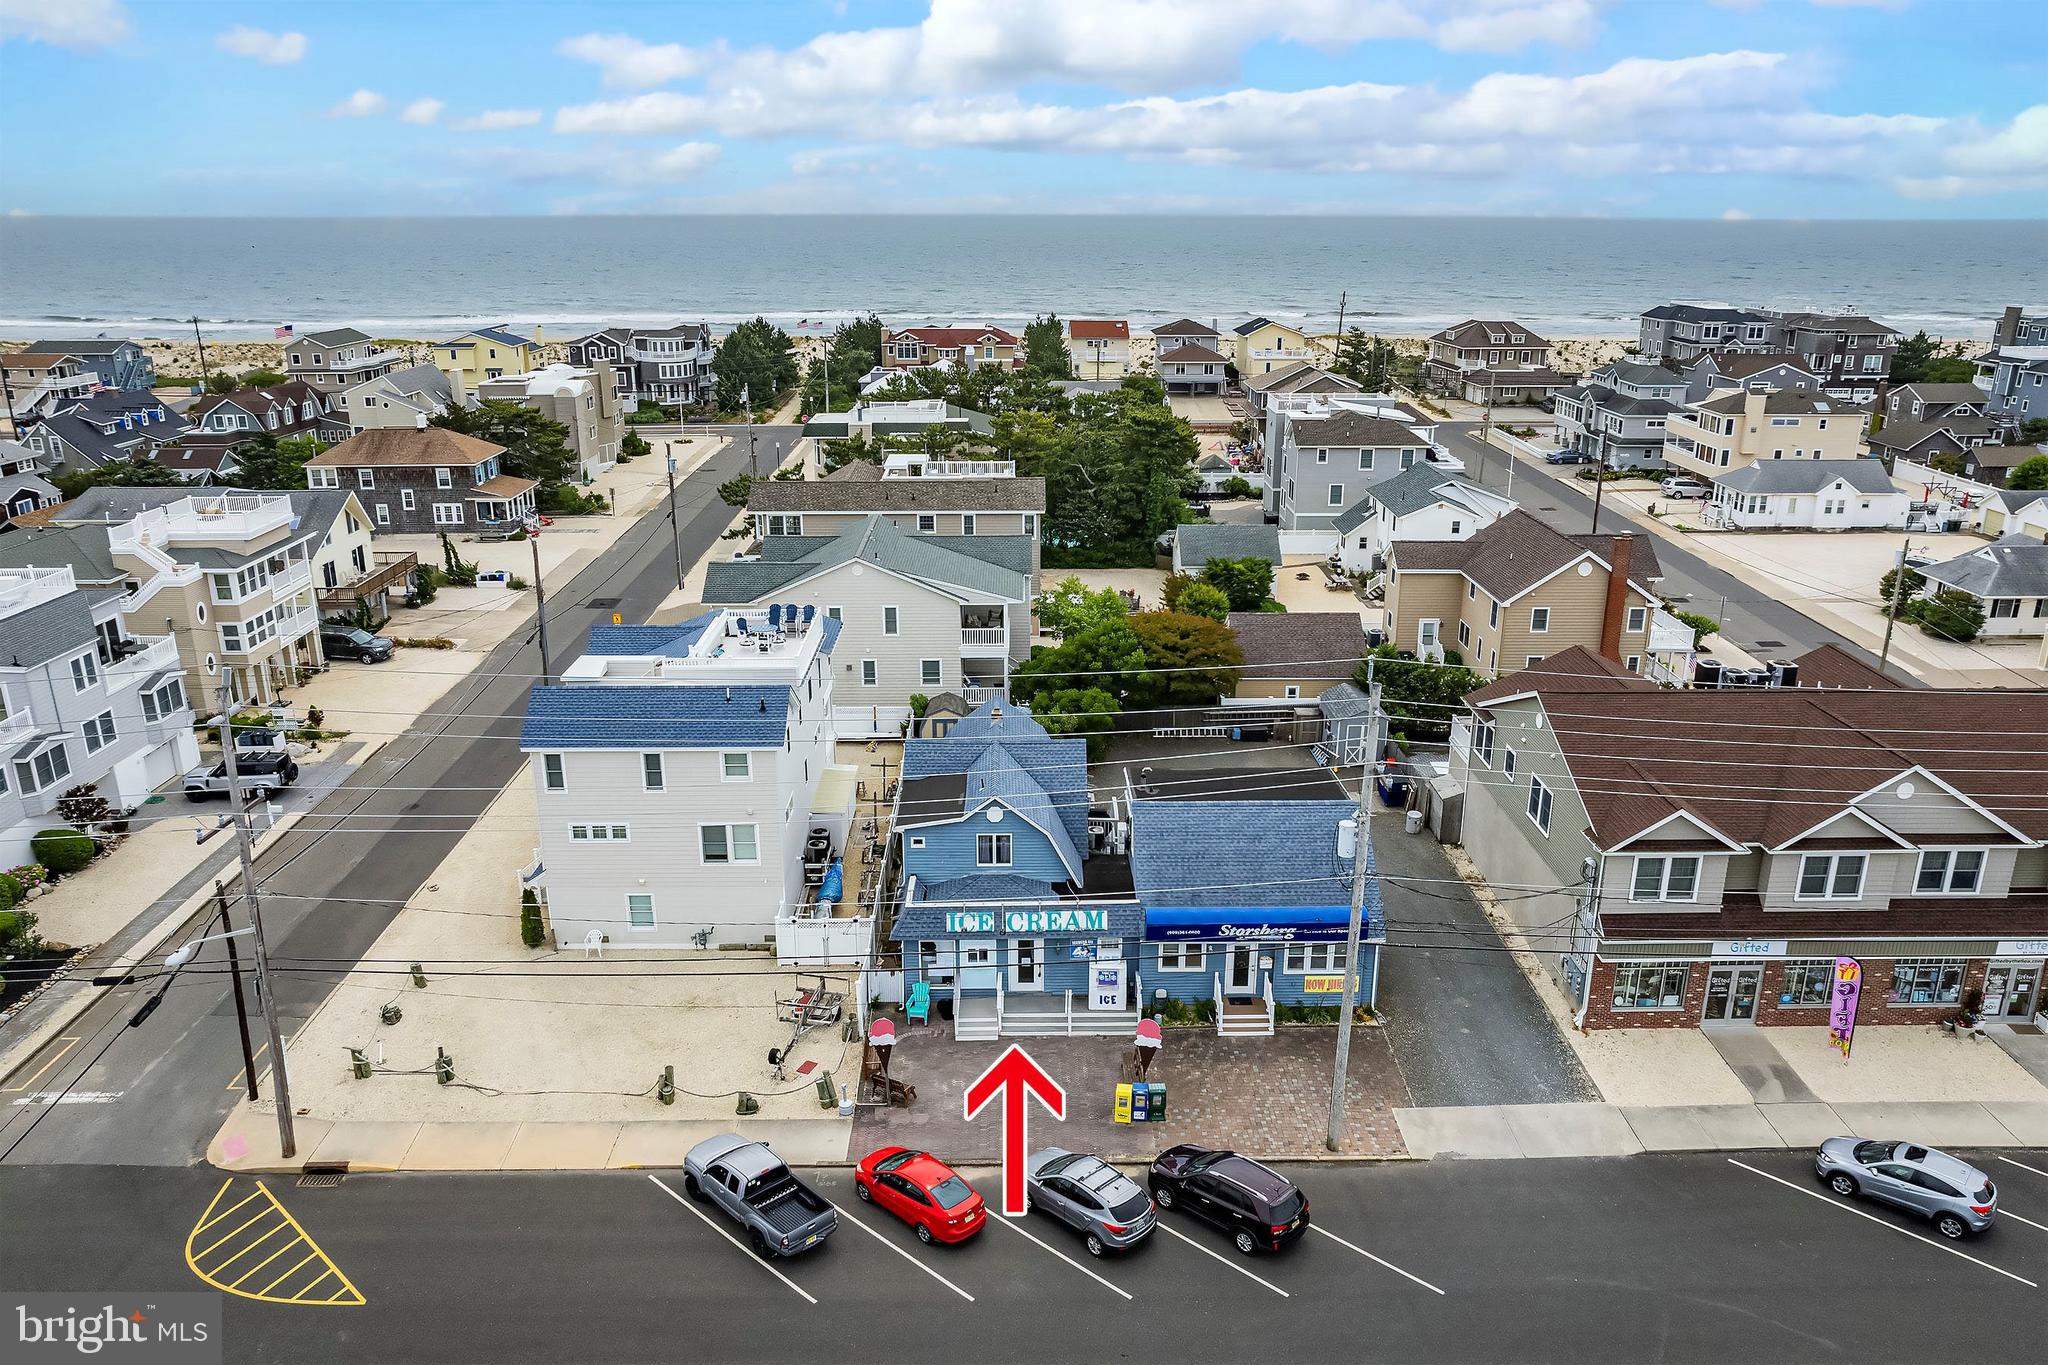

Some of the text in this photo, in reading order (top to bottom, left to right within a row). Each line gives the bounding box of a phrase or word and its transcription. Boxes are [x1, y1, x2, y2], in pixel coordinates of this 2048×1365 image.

[946, 910, 1105, 932] ICE CREAM
[1730, 942, 1770, 952] Gifted
[1306, 979, 1326, 990] NOW
[1099, 995, 1117, 1005] ICE
